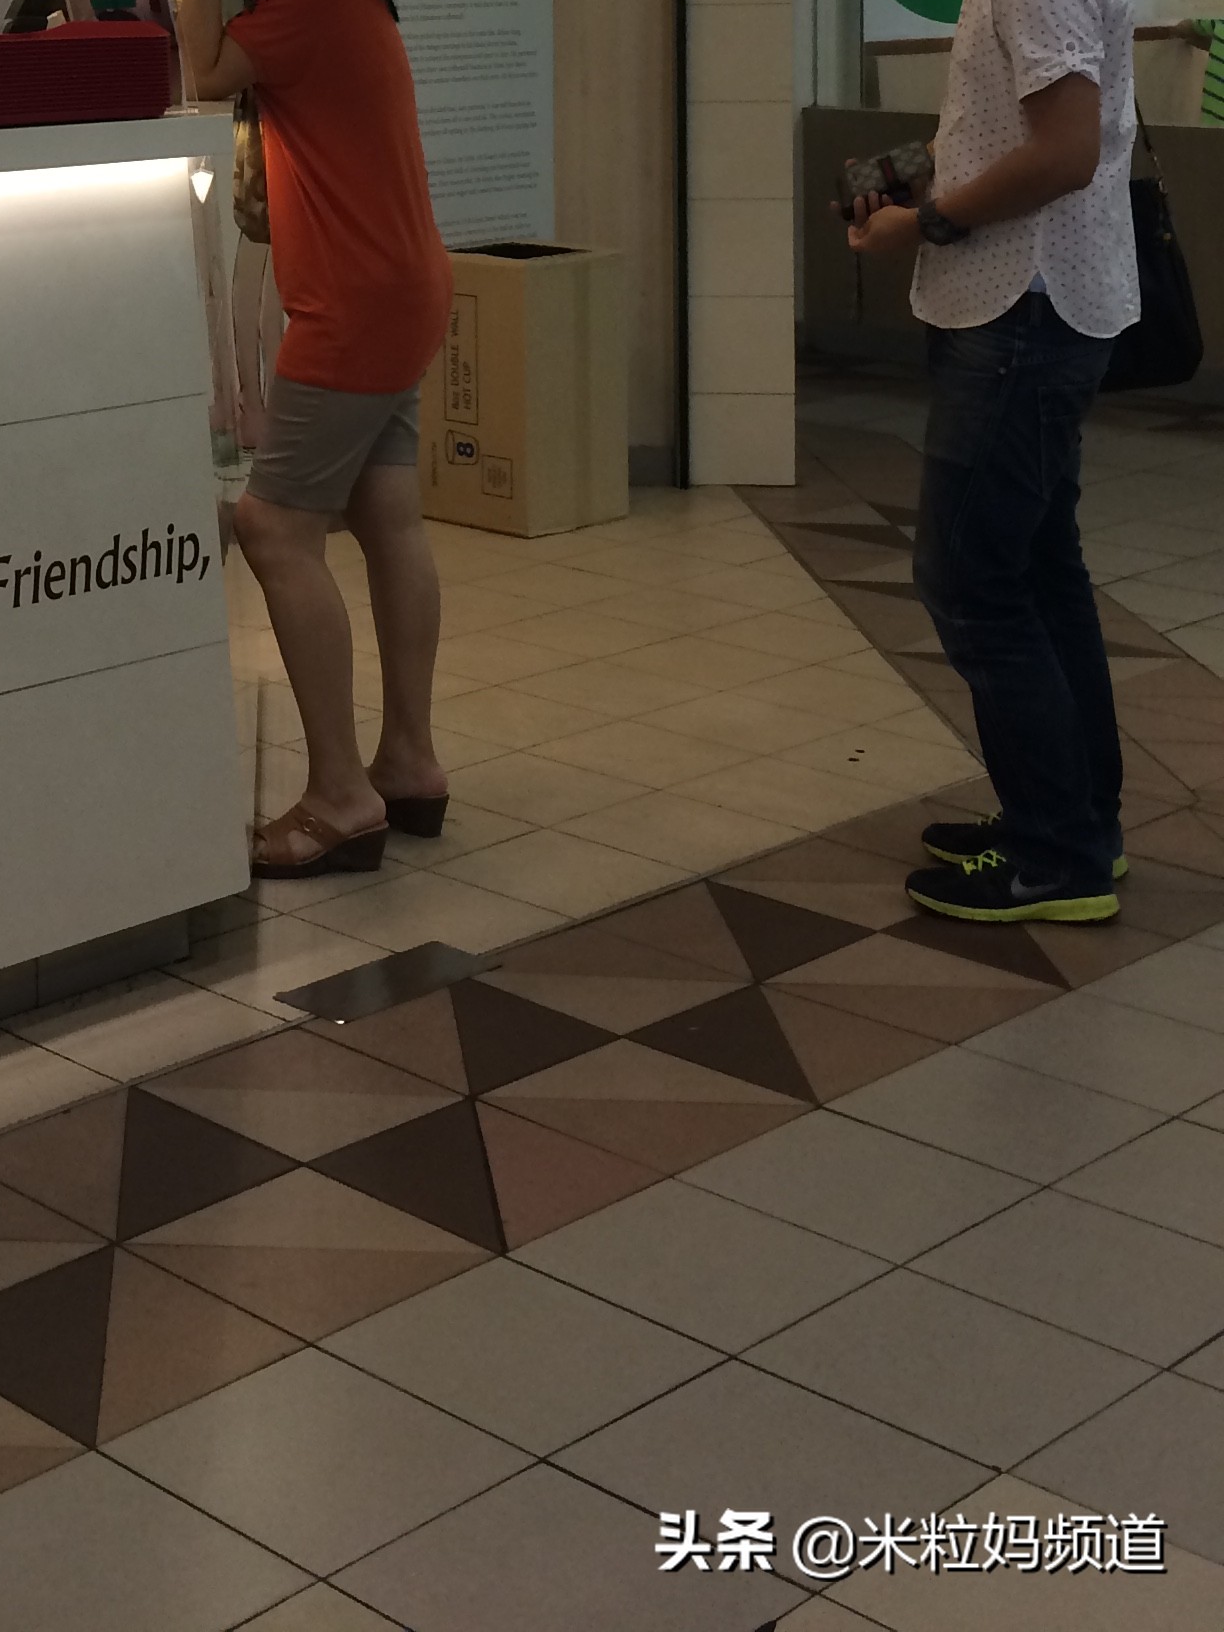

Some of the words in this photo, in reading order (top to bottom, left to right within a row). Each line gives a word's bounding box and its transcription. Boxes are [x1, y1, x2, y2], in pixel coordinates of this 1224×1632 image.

[450, 310, 459, 337] WALL
[450, 344, 459, 389] DOUBLE
[462, 361, 471, 383] CUP
[463, 388, 471, 410] HOT
[456, 441, 474, 458] 8
